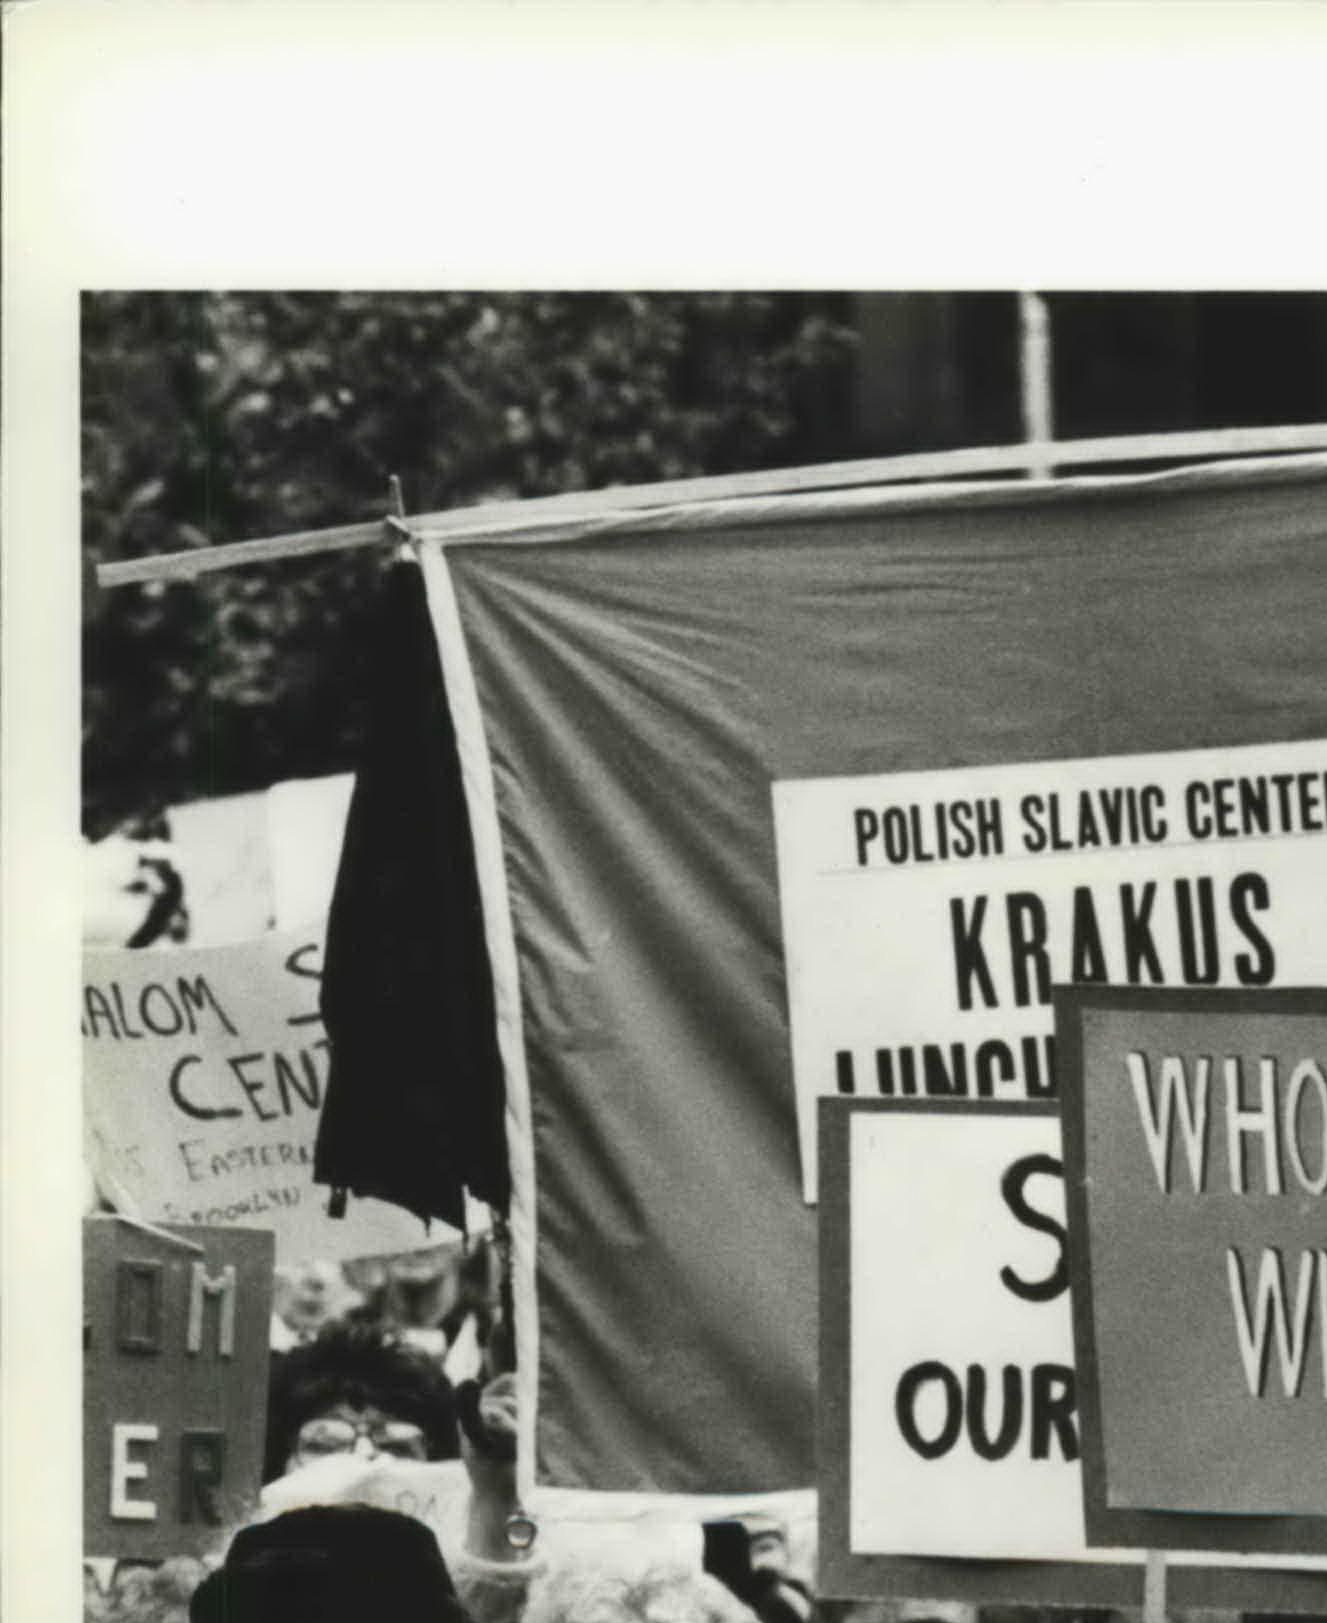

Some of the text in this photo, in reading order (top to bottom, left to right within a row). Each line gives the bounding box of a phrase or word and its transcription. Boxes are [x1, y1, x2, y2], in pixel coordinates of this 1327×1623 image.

[853, 797, 1003, 867] POLISH
[1022, 784, 1168, 856] SLAVIC
[948, 871, 1277, 1011] KRAKUS
[82, 973, 240, 1040] ALOM
[168, 1038, 334, 1121] CEN
[1000, 1154, 1072, 1302] S
[82, 1256, 238, 1358] OM
[894, 1360, 1080, 1461] OUR
